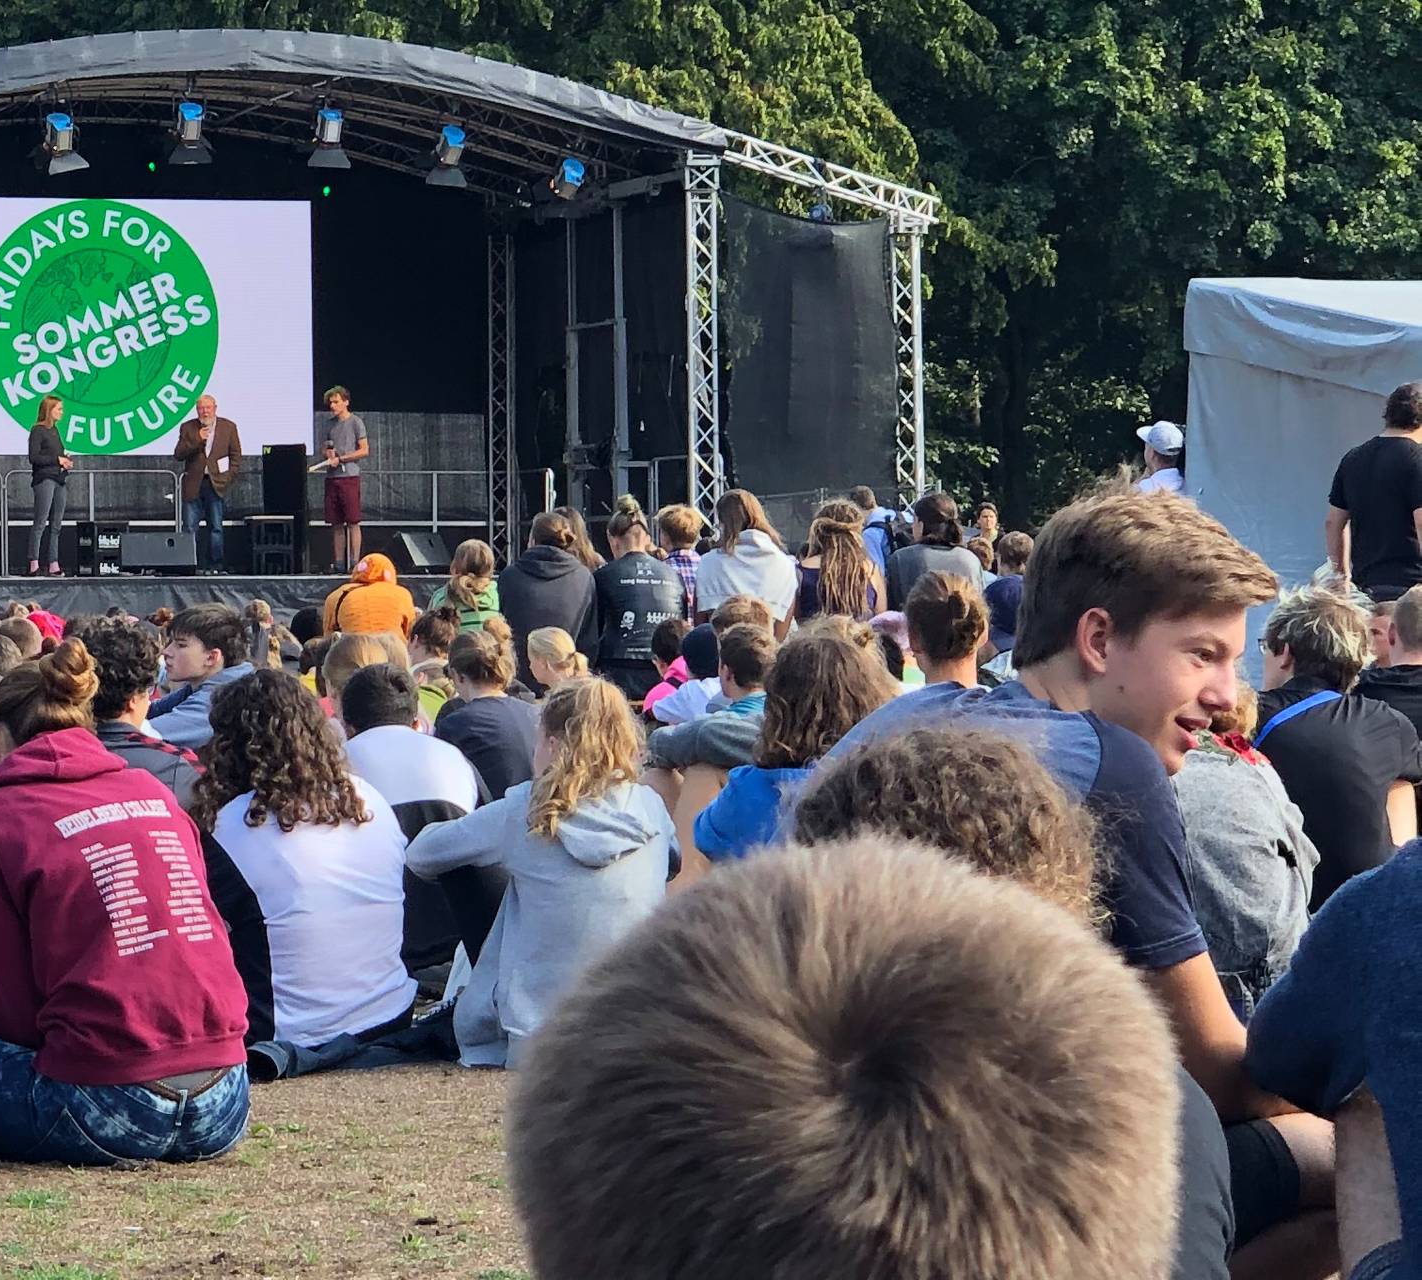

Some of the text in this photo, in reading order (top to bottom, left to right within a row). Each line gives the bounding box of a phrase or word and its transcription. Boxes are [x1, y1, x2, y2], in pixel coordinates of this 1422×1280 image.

[102, 210, 172, 263] FOR
[1, 294, 212, 408] KONGRESS
[12, 272, 182, 366] SOMMER
[65, 363, 202, 448] FUTURE
